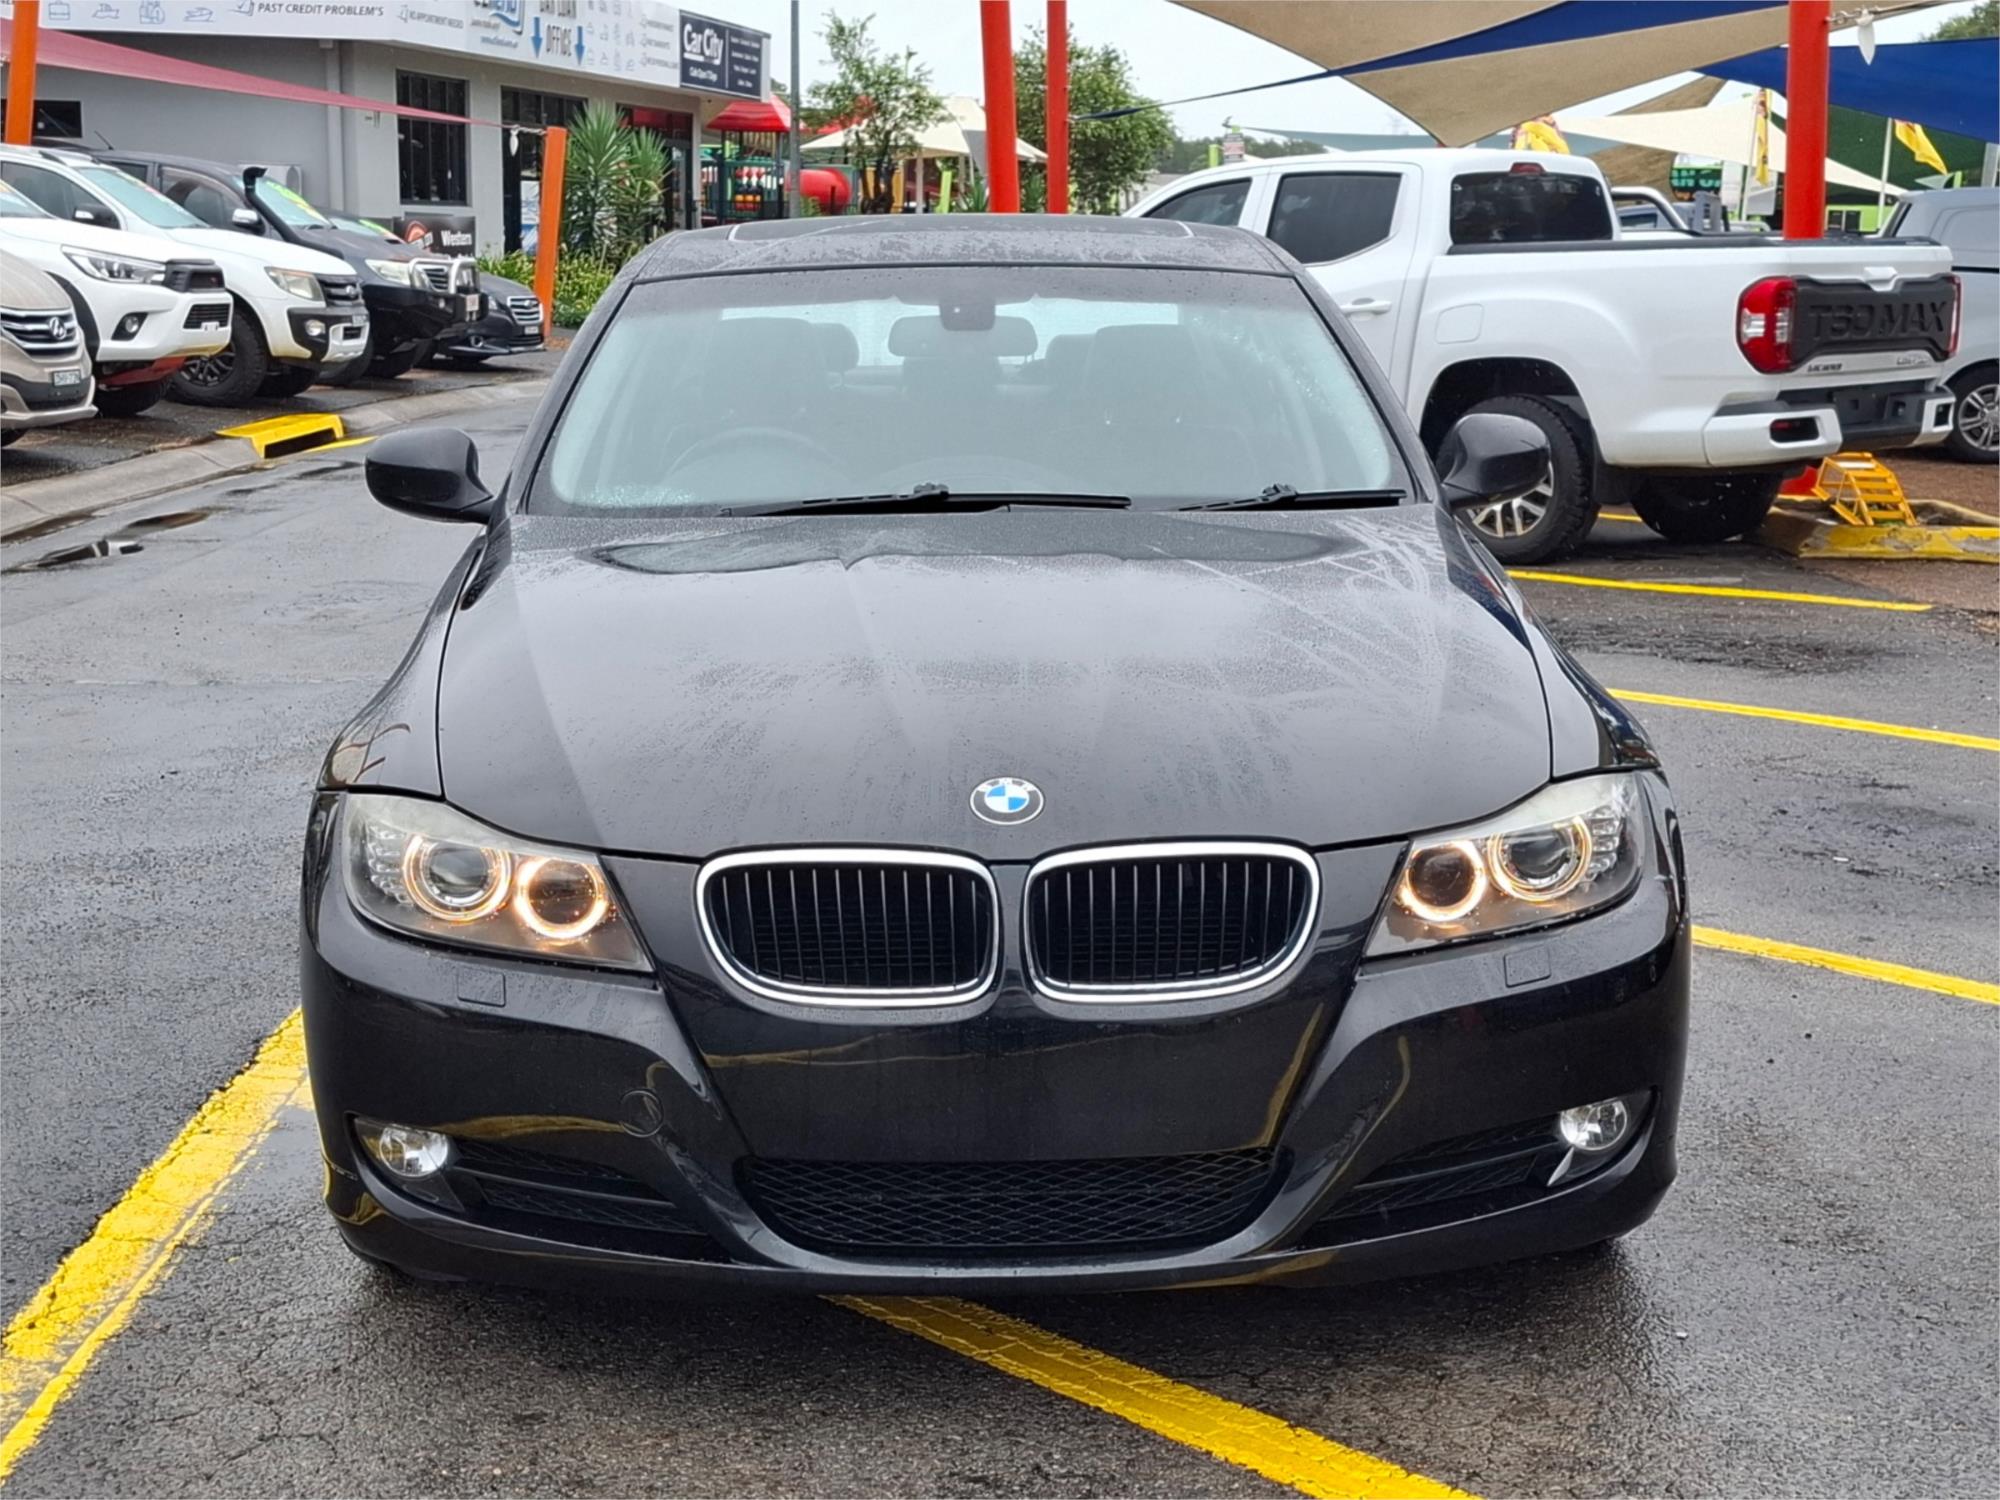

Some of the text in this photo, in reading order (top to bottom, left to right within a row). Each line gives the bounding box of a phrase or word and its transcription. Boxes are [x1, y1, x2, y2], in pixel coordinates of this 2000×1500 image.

[258, 2, 384, 17] PAST CREDIT PROBLEM'S
[684, 23, 702, 54] Car
[703, 28, 724, 65] City
[1878, 301, 1948, 337] MAX
